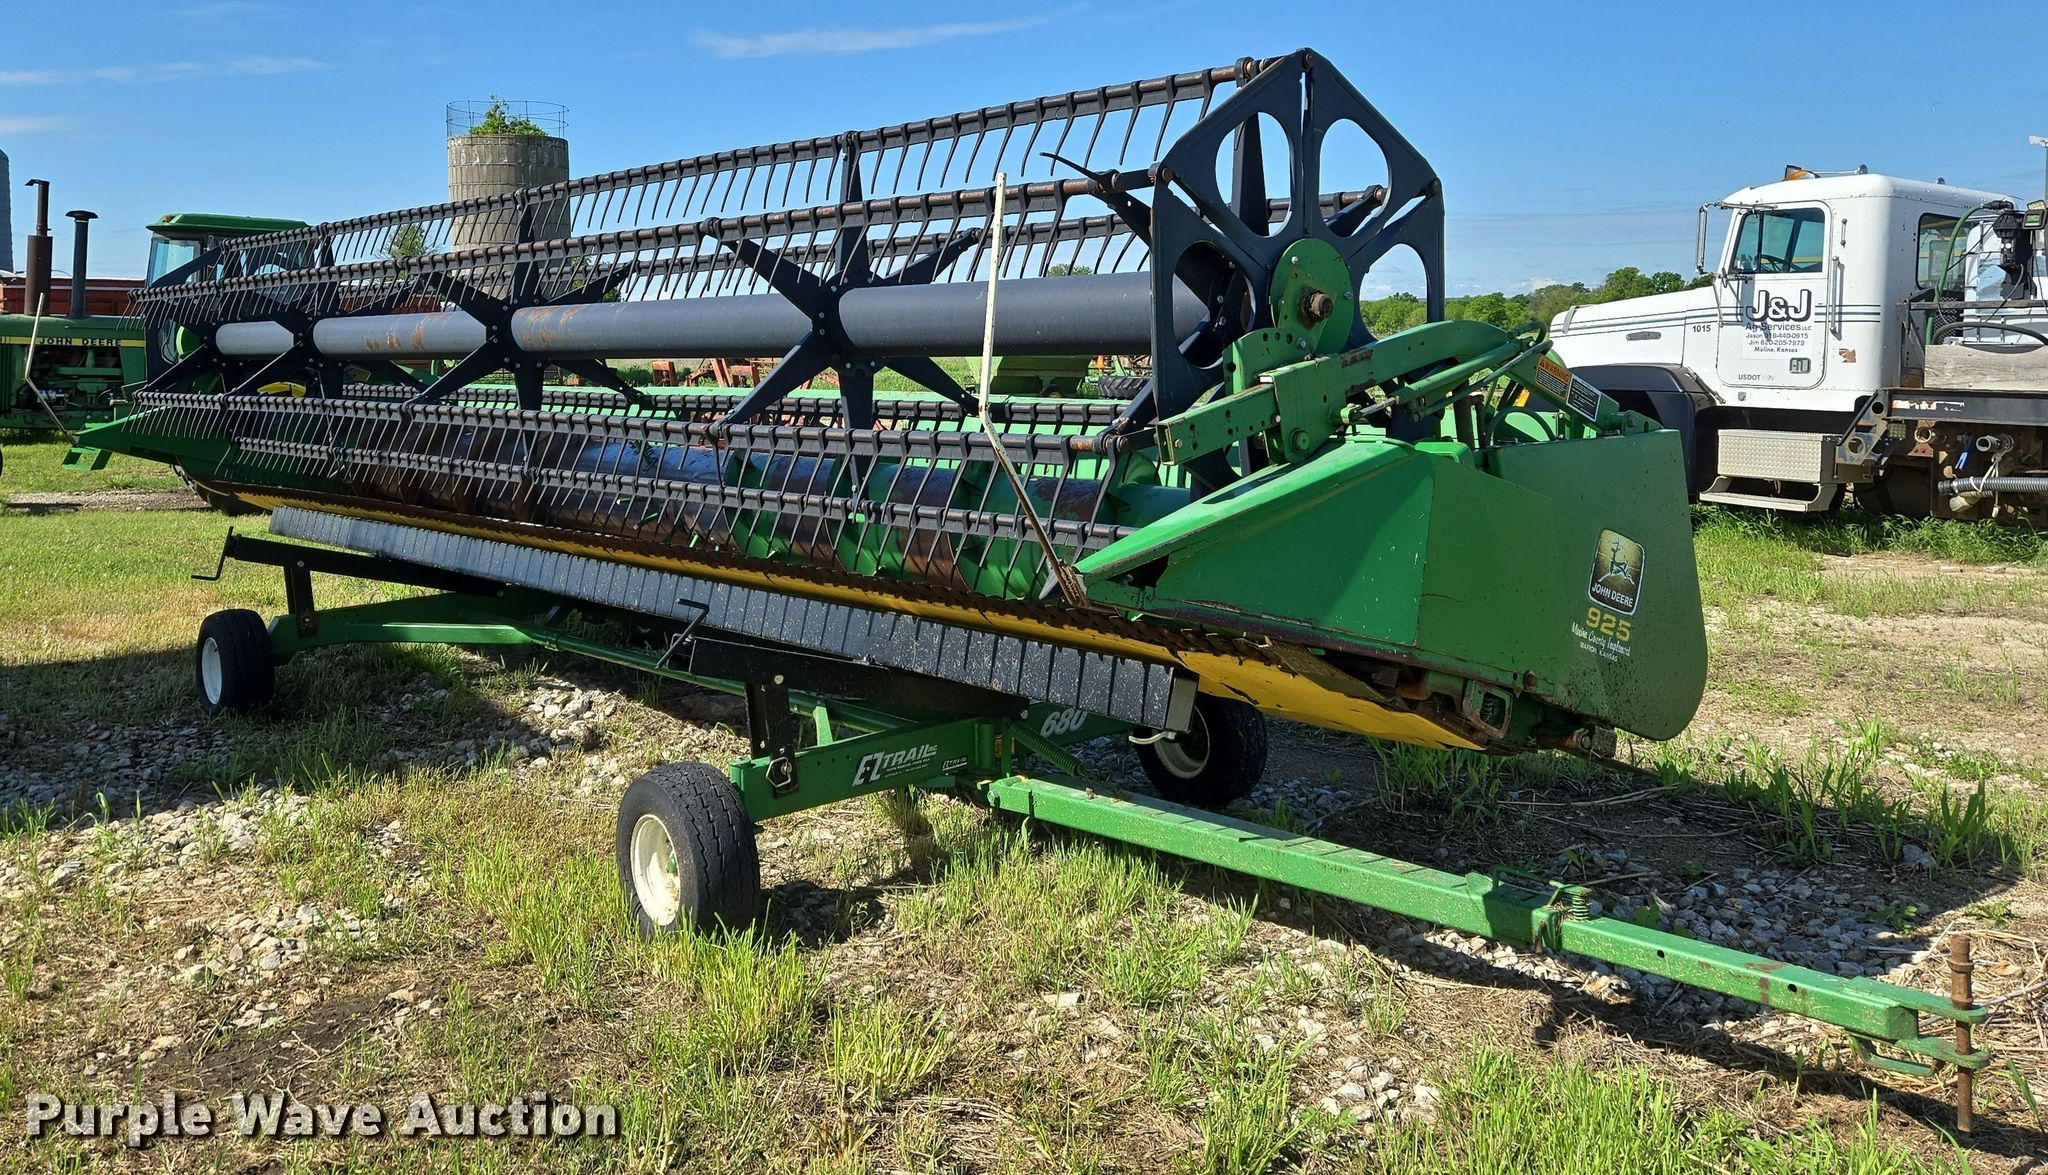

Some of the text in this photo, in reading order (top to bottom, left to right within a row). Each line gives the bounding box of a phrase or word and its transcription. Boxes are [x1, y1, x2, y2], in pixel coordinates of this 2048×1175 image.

[1746, 289, 1812, 322] J&J
[1692, 324, 1711, 332] 1015
[1746, 322, 1758, 332] Ag
[1760, 322, 1801, 331] Services
[40, 336, 121, 347] JOHN DEERE
[1591, 582, 1634, 607] JOHN DEERE
[1586, 606, 1631, 642] 925
[1040, 707, 1088, 738] 680
